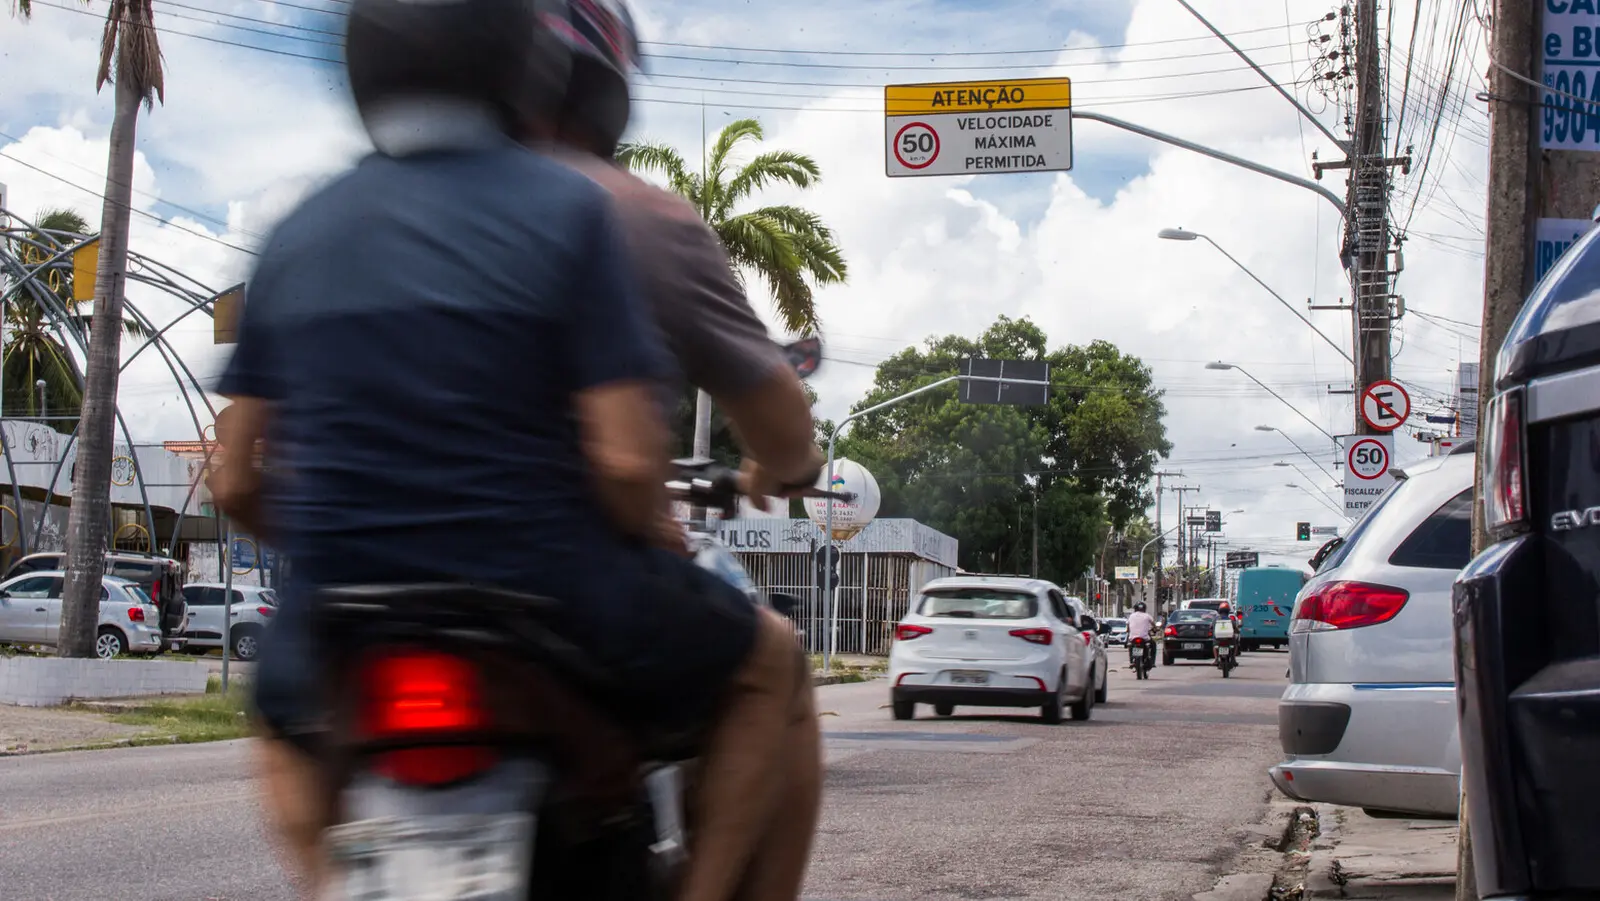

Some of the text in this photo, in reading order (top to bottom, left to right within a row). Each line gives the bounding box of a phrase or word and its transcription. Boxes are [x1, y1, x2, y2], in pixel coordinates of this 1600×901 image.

[1545, 33, 1562, 57] e
[931, 86, 1025, 109] ATENÇÃO
[957, 115, 1053, 131] VELOCIDADE
[902, 133, 933, 153] 50
[975, 134, 1036, 149] MÁXIMA
[965, 155, 1046, 169] PERMITIDA
[1376, 391, 1395, 420] E
[1356, 447, 1382, 465] 50
[1346, 501, 1372, 509] ELETR
[713, 529, 771, 548] ULOS
